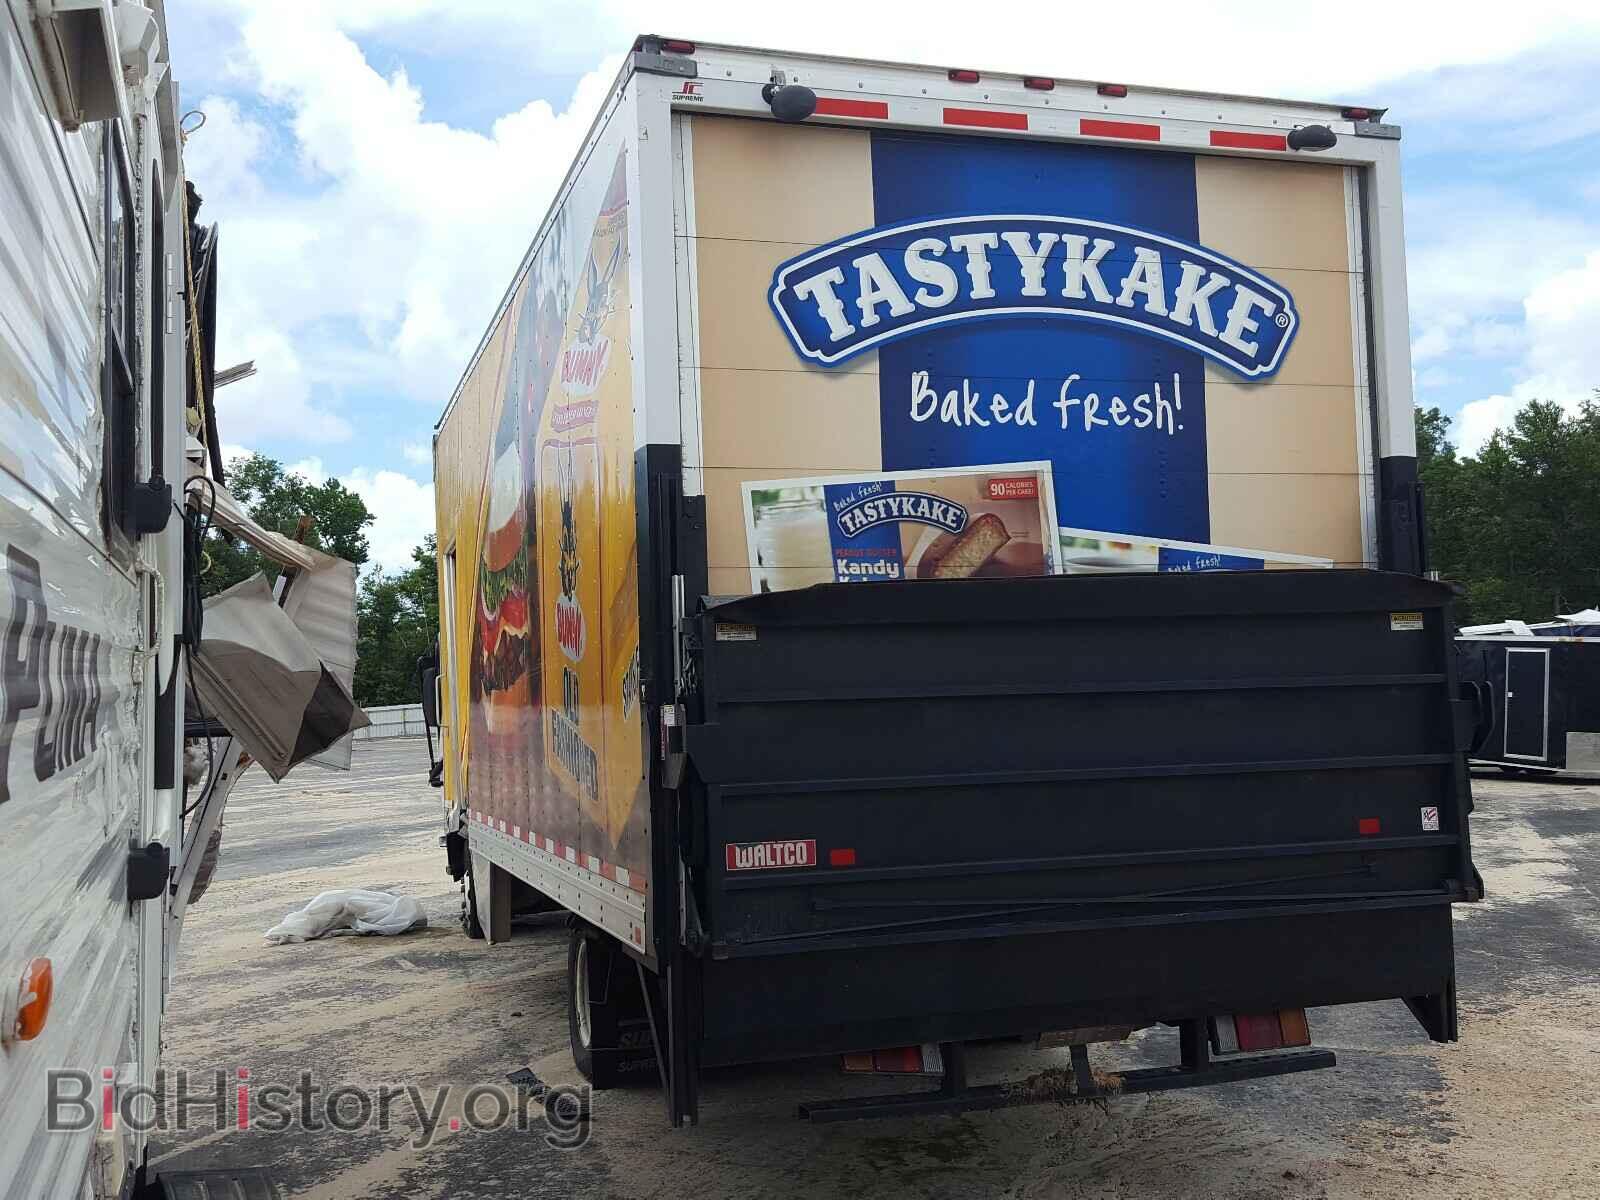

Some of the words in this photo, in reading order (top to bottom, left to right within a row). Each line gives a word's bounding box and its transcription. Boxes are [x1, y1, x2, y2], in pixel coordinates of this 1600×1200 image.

[671, 94, 704, 102] SUPREME
[793, 231, 1278, 358] TASTYKAKE
[561, 340, 608, 385] BUNNY
[910, 371, 1037, 428] Baked
[1052, 372, 1185, 435] fresh!
[991, 483, 1005, 496] 90
[841, 496, 960, 532] TASTYKAKE
[837, 559, 899, 579] Kandy
[557, 602, 581, 658] BUNNY
[735, 842, 807, 868] WALTCO
